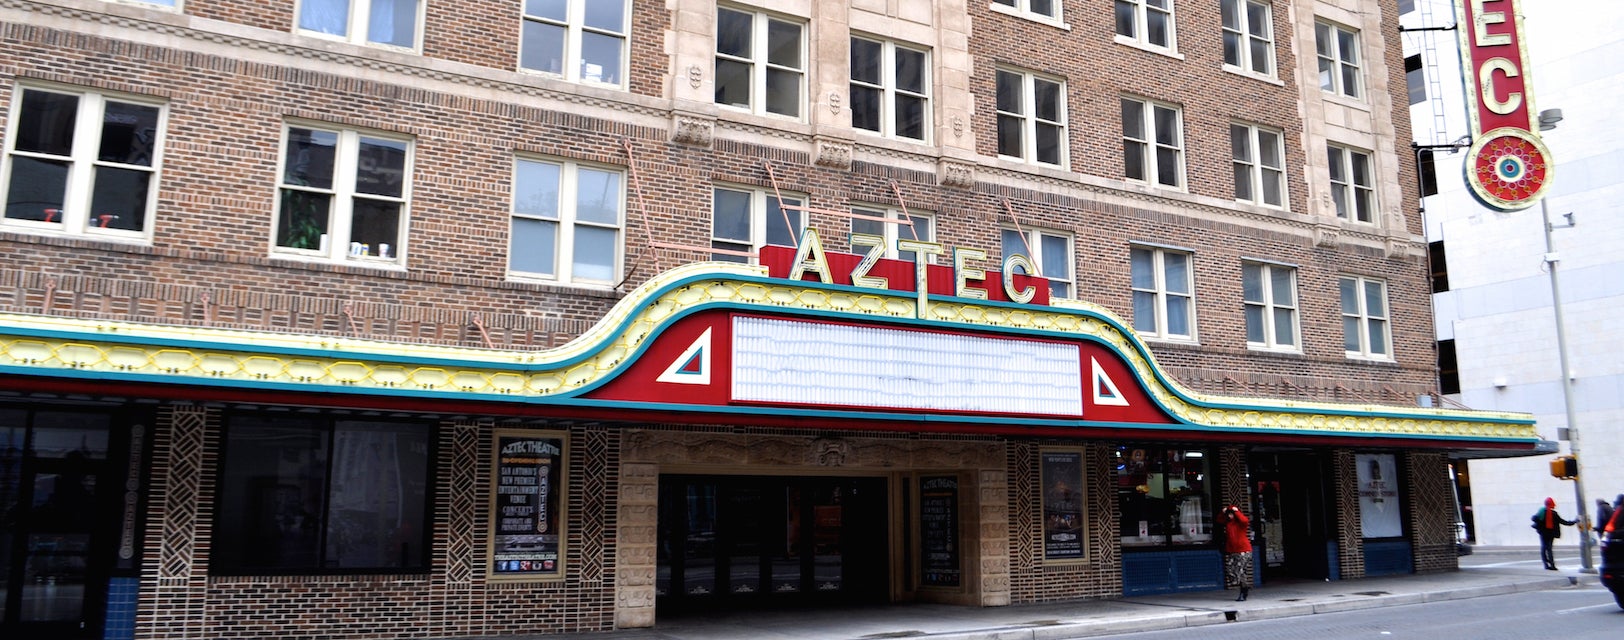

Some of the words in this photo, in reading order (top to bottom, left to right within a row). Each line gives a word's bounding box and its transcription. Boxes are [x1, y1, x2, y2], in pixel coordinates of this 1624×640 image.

[789, 226, 1036, 320] AZTEC
[501, 441, 526, 454] AZTEC
[526, 440, 560, 456] THEATRE
[501, 467, 511, 475] SAN
[502, 476, 513, 484] NEW
[498, 485, 538, 494] ENTERTAINMENT
[510, 495, 526, 503] VENUE
[502, 505, 534, 513] CONCERTS
